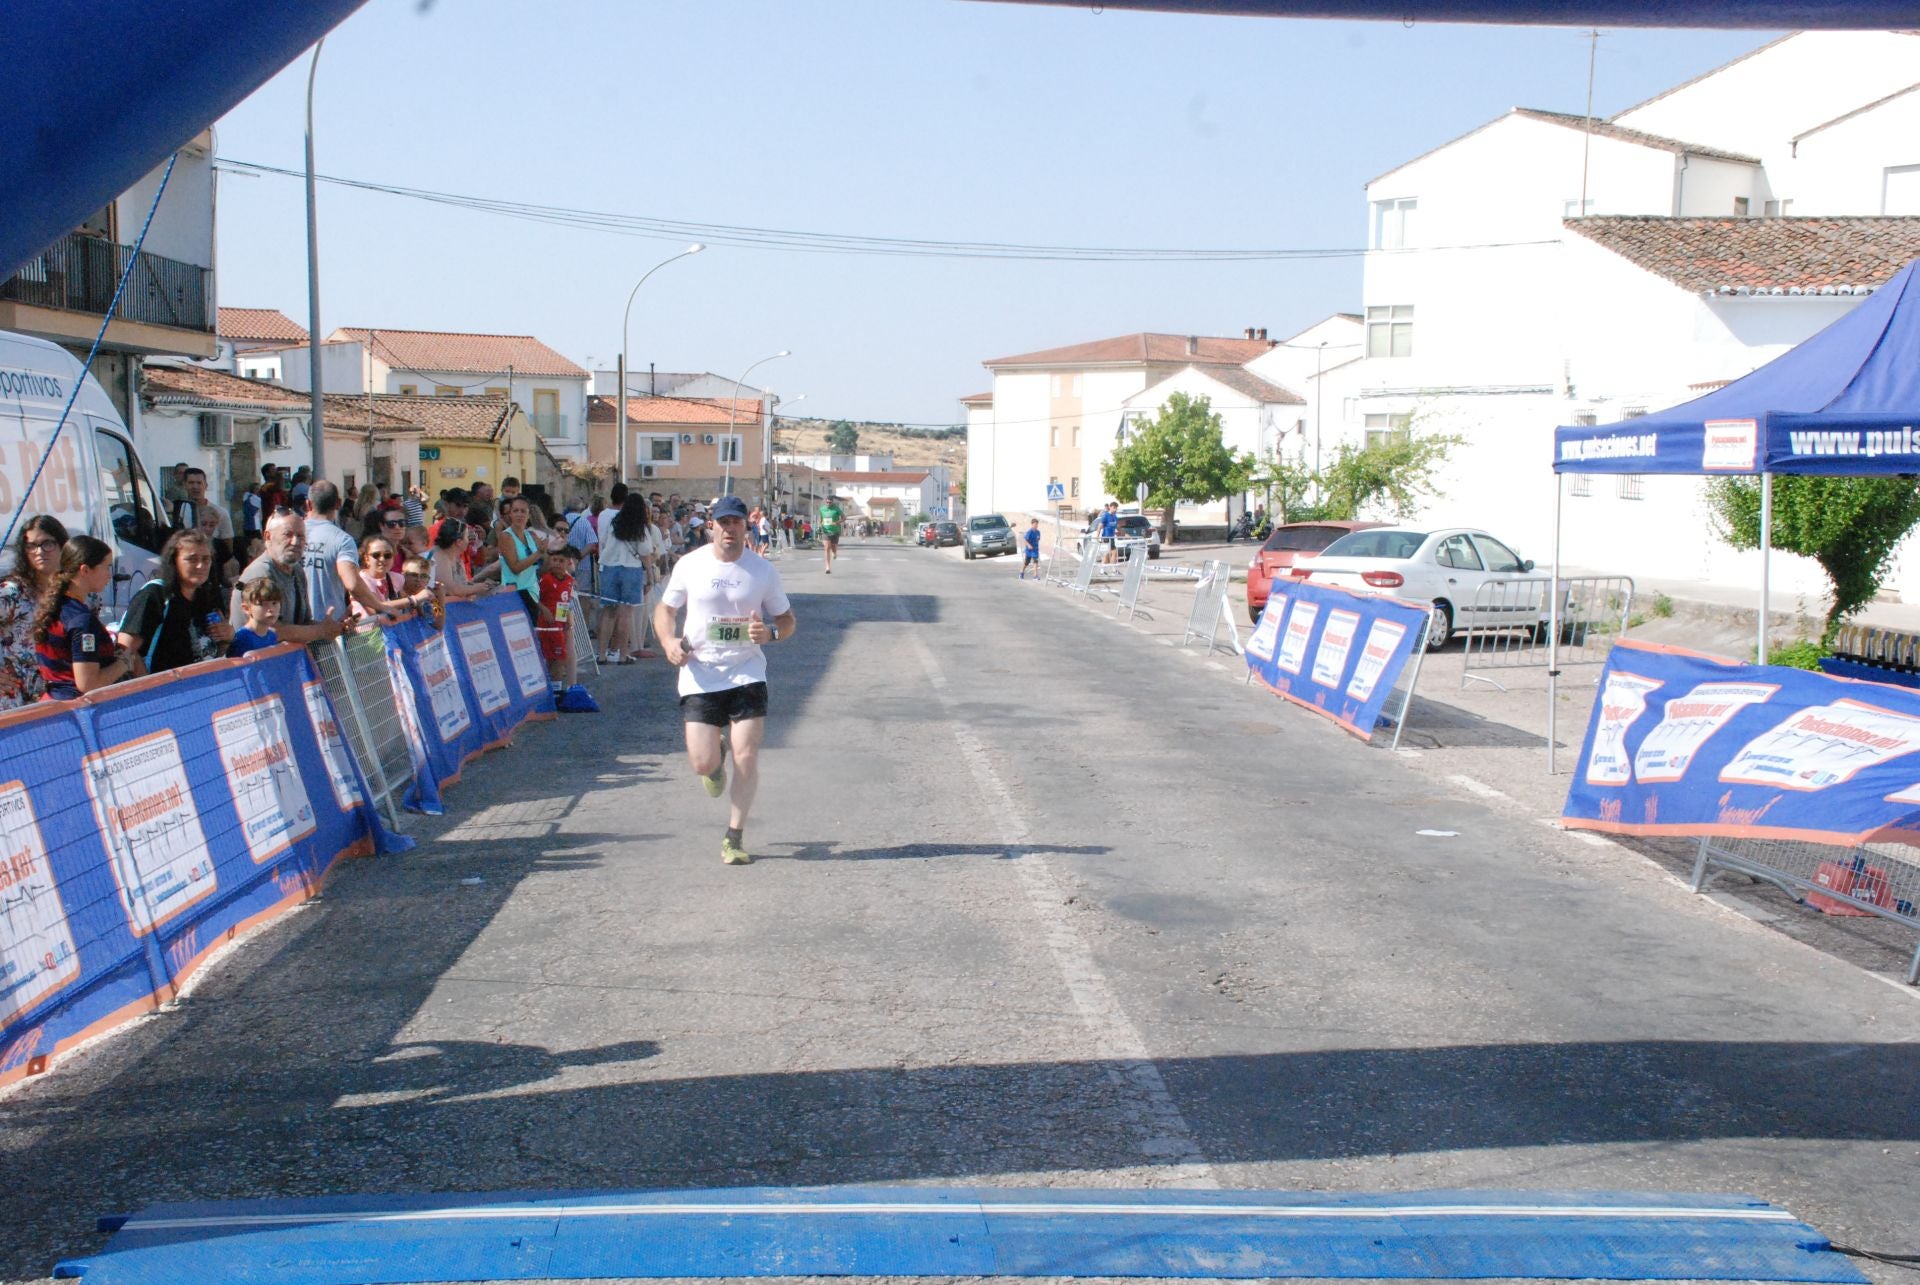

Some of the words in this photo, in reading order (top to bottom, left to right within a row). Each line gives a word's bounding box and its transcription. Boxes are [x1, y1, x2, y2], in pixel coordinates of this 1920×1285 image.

[0, 368, 63, 399] portivos
[718, 626, 741, 641] 184
[1791, 714, 1909, 750] Pulsaciones.net
